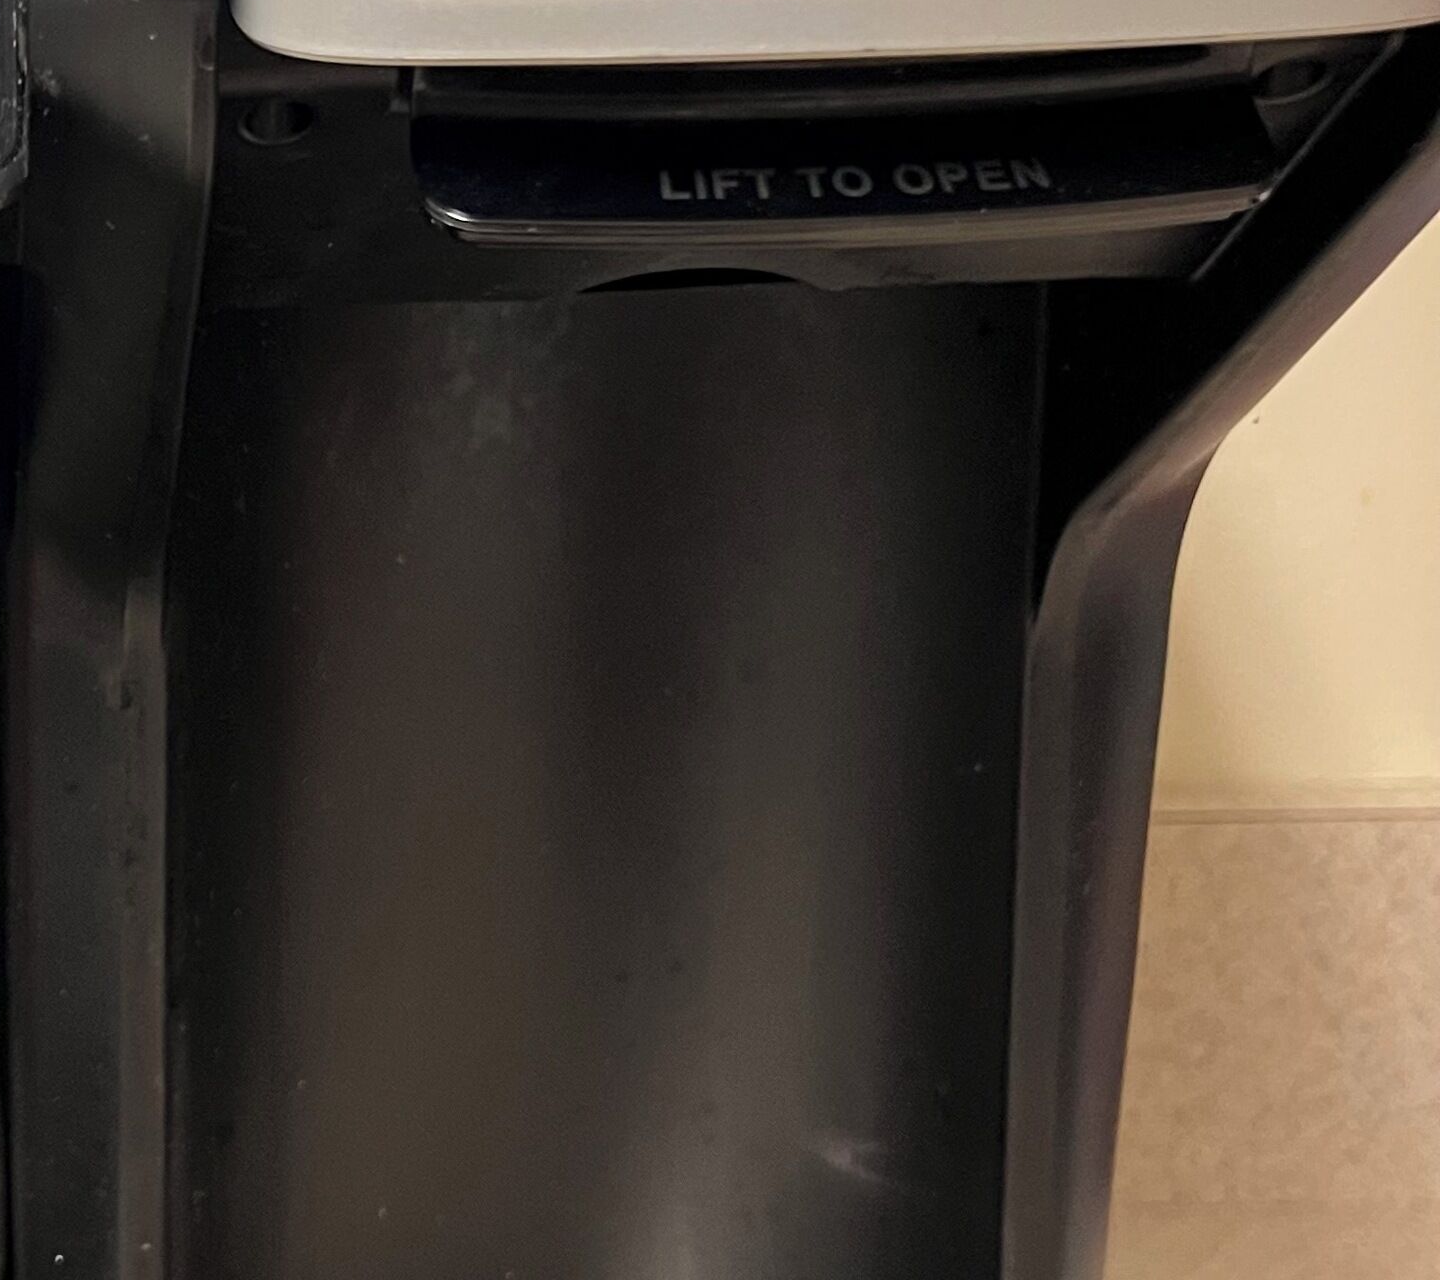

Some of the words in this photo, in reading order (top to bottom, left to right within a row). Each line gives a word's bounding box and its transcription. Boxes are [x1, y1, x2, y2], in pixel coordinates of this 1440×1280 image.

[661, 167, 776, 201] LIFT
[795, 164, 874, 198] TO
[893, 157, 1052, 195] OPEN
